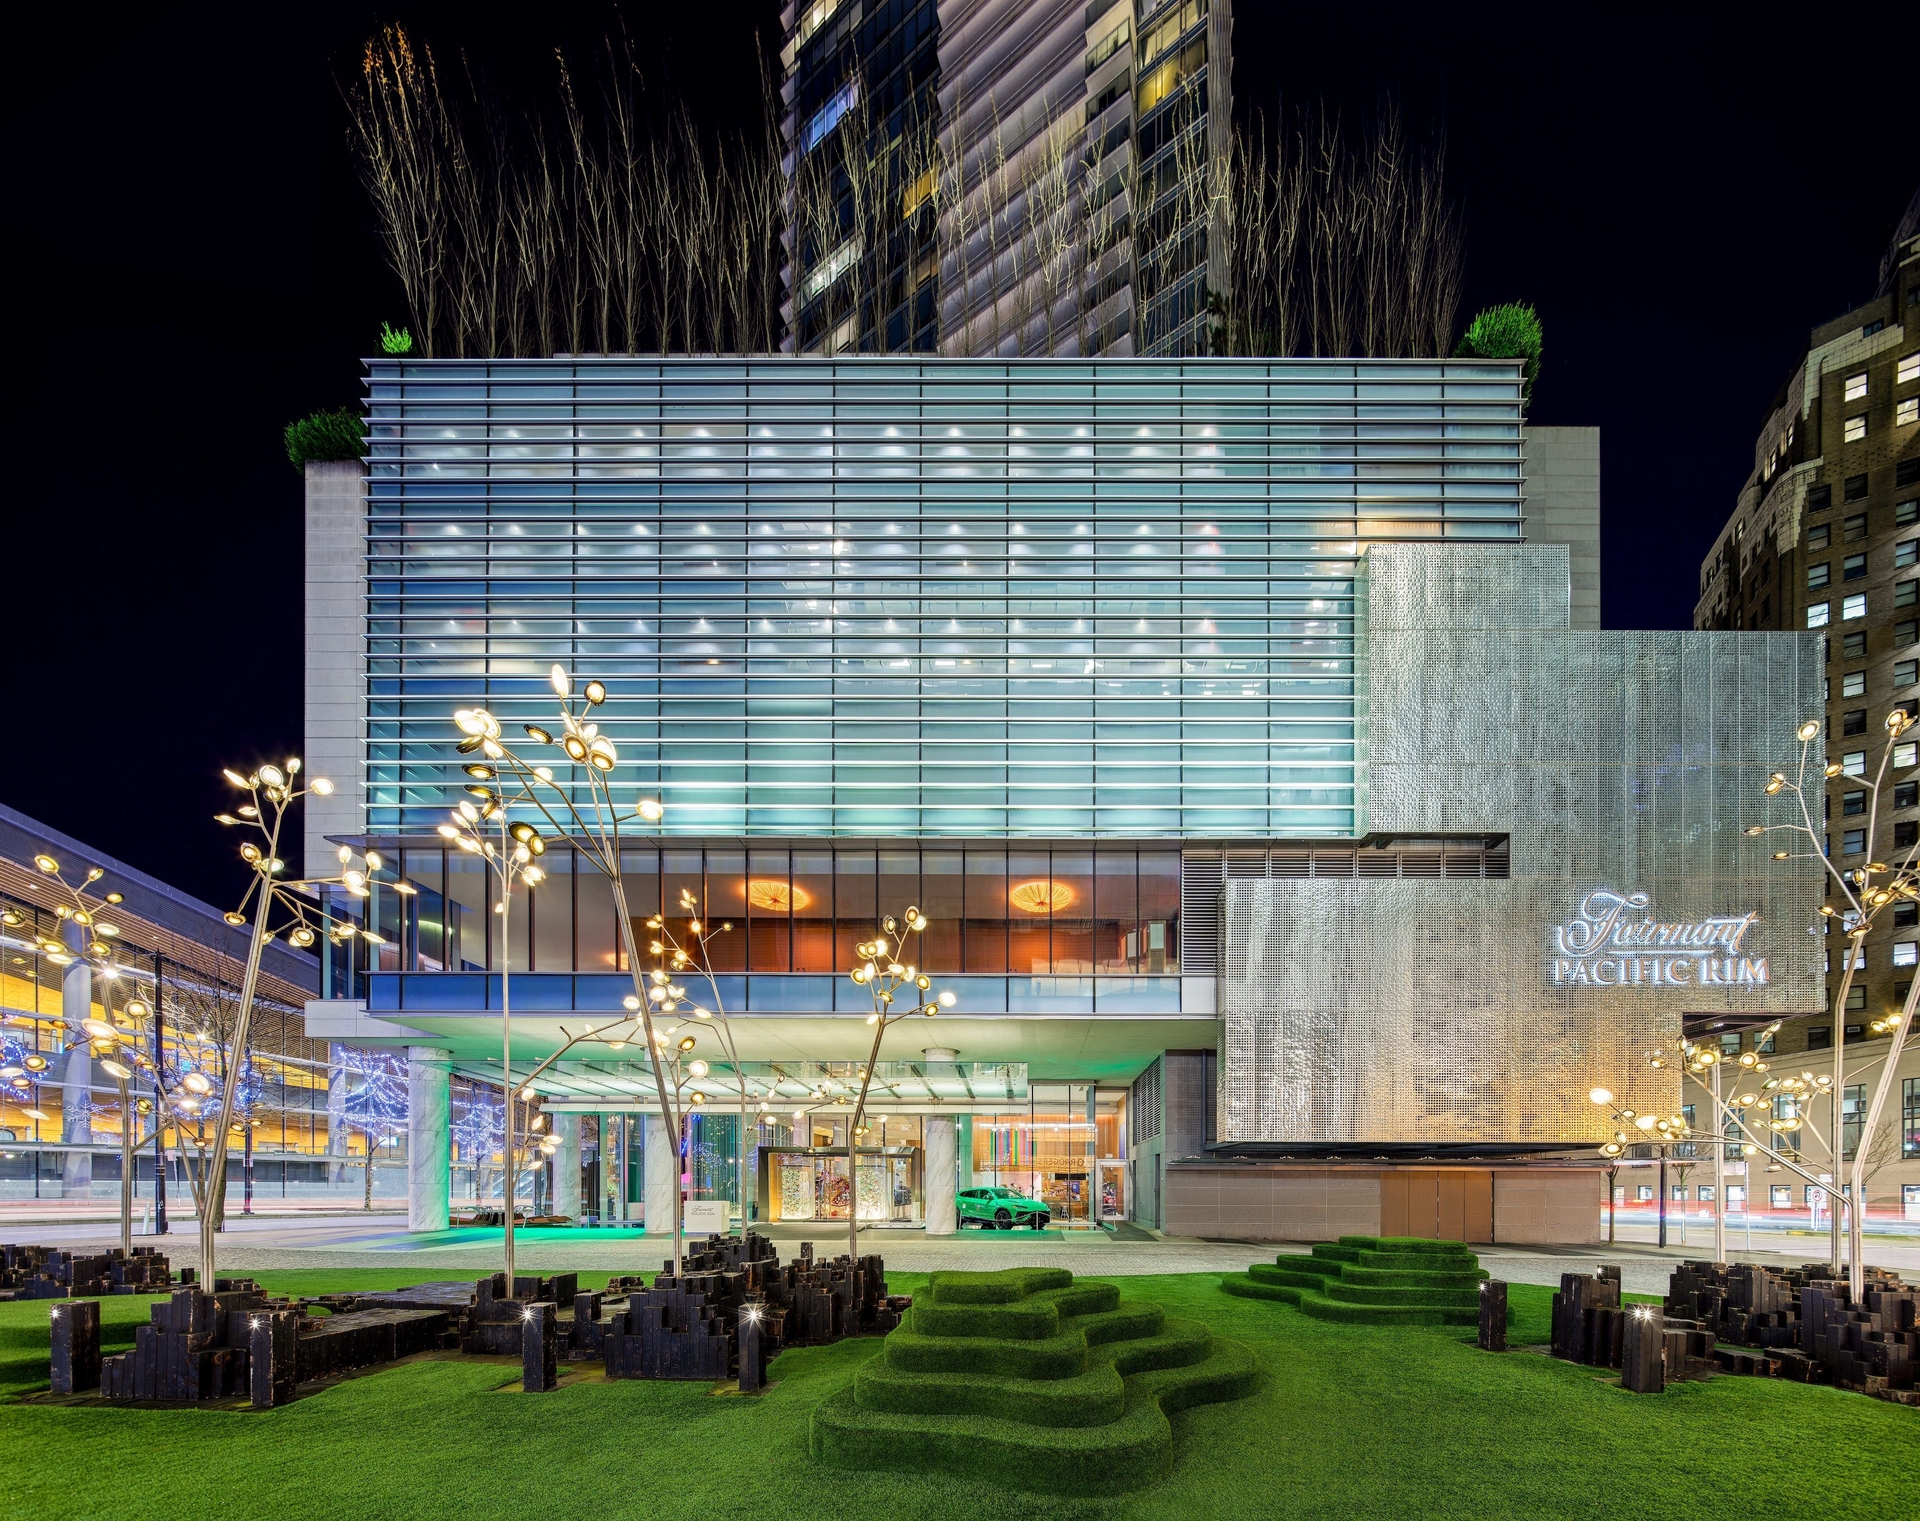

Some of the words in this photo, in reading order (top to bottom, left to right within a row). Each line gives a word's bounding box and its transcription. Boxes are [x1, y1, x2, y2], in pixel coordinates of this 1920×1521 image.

[1559, 888, 1763, 955] Fairmont
[1556, 957, 1691, 983] PACIFIC
[1705, 957, 1770, 983] RIM
